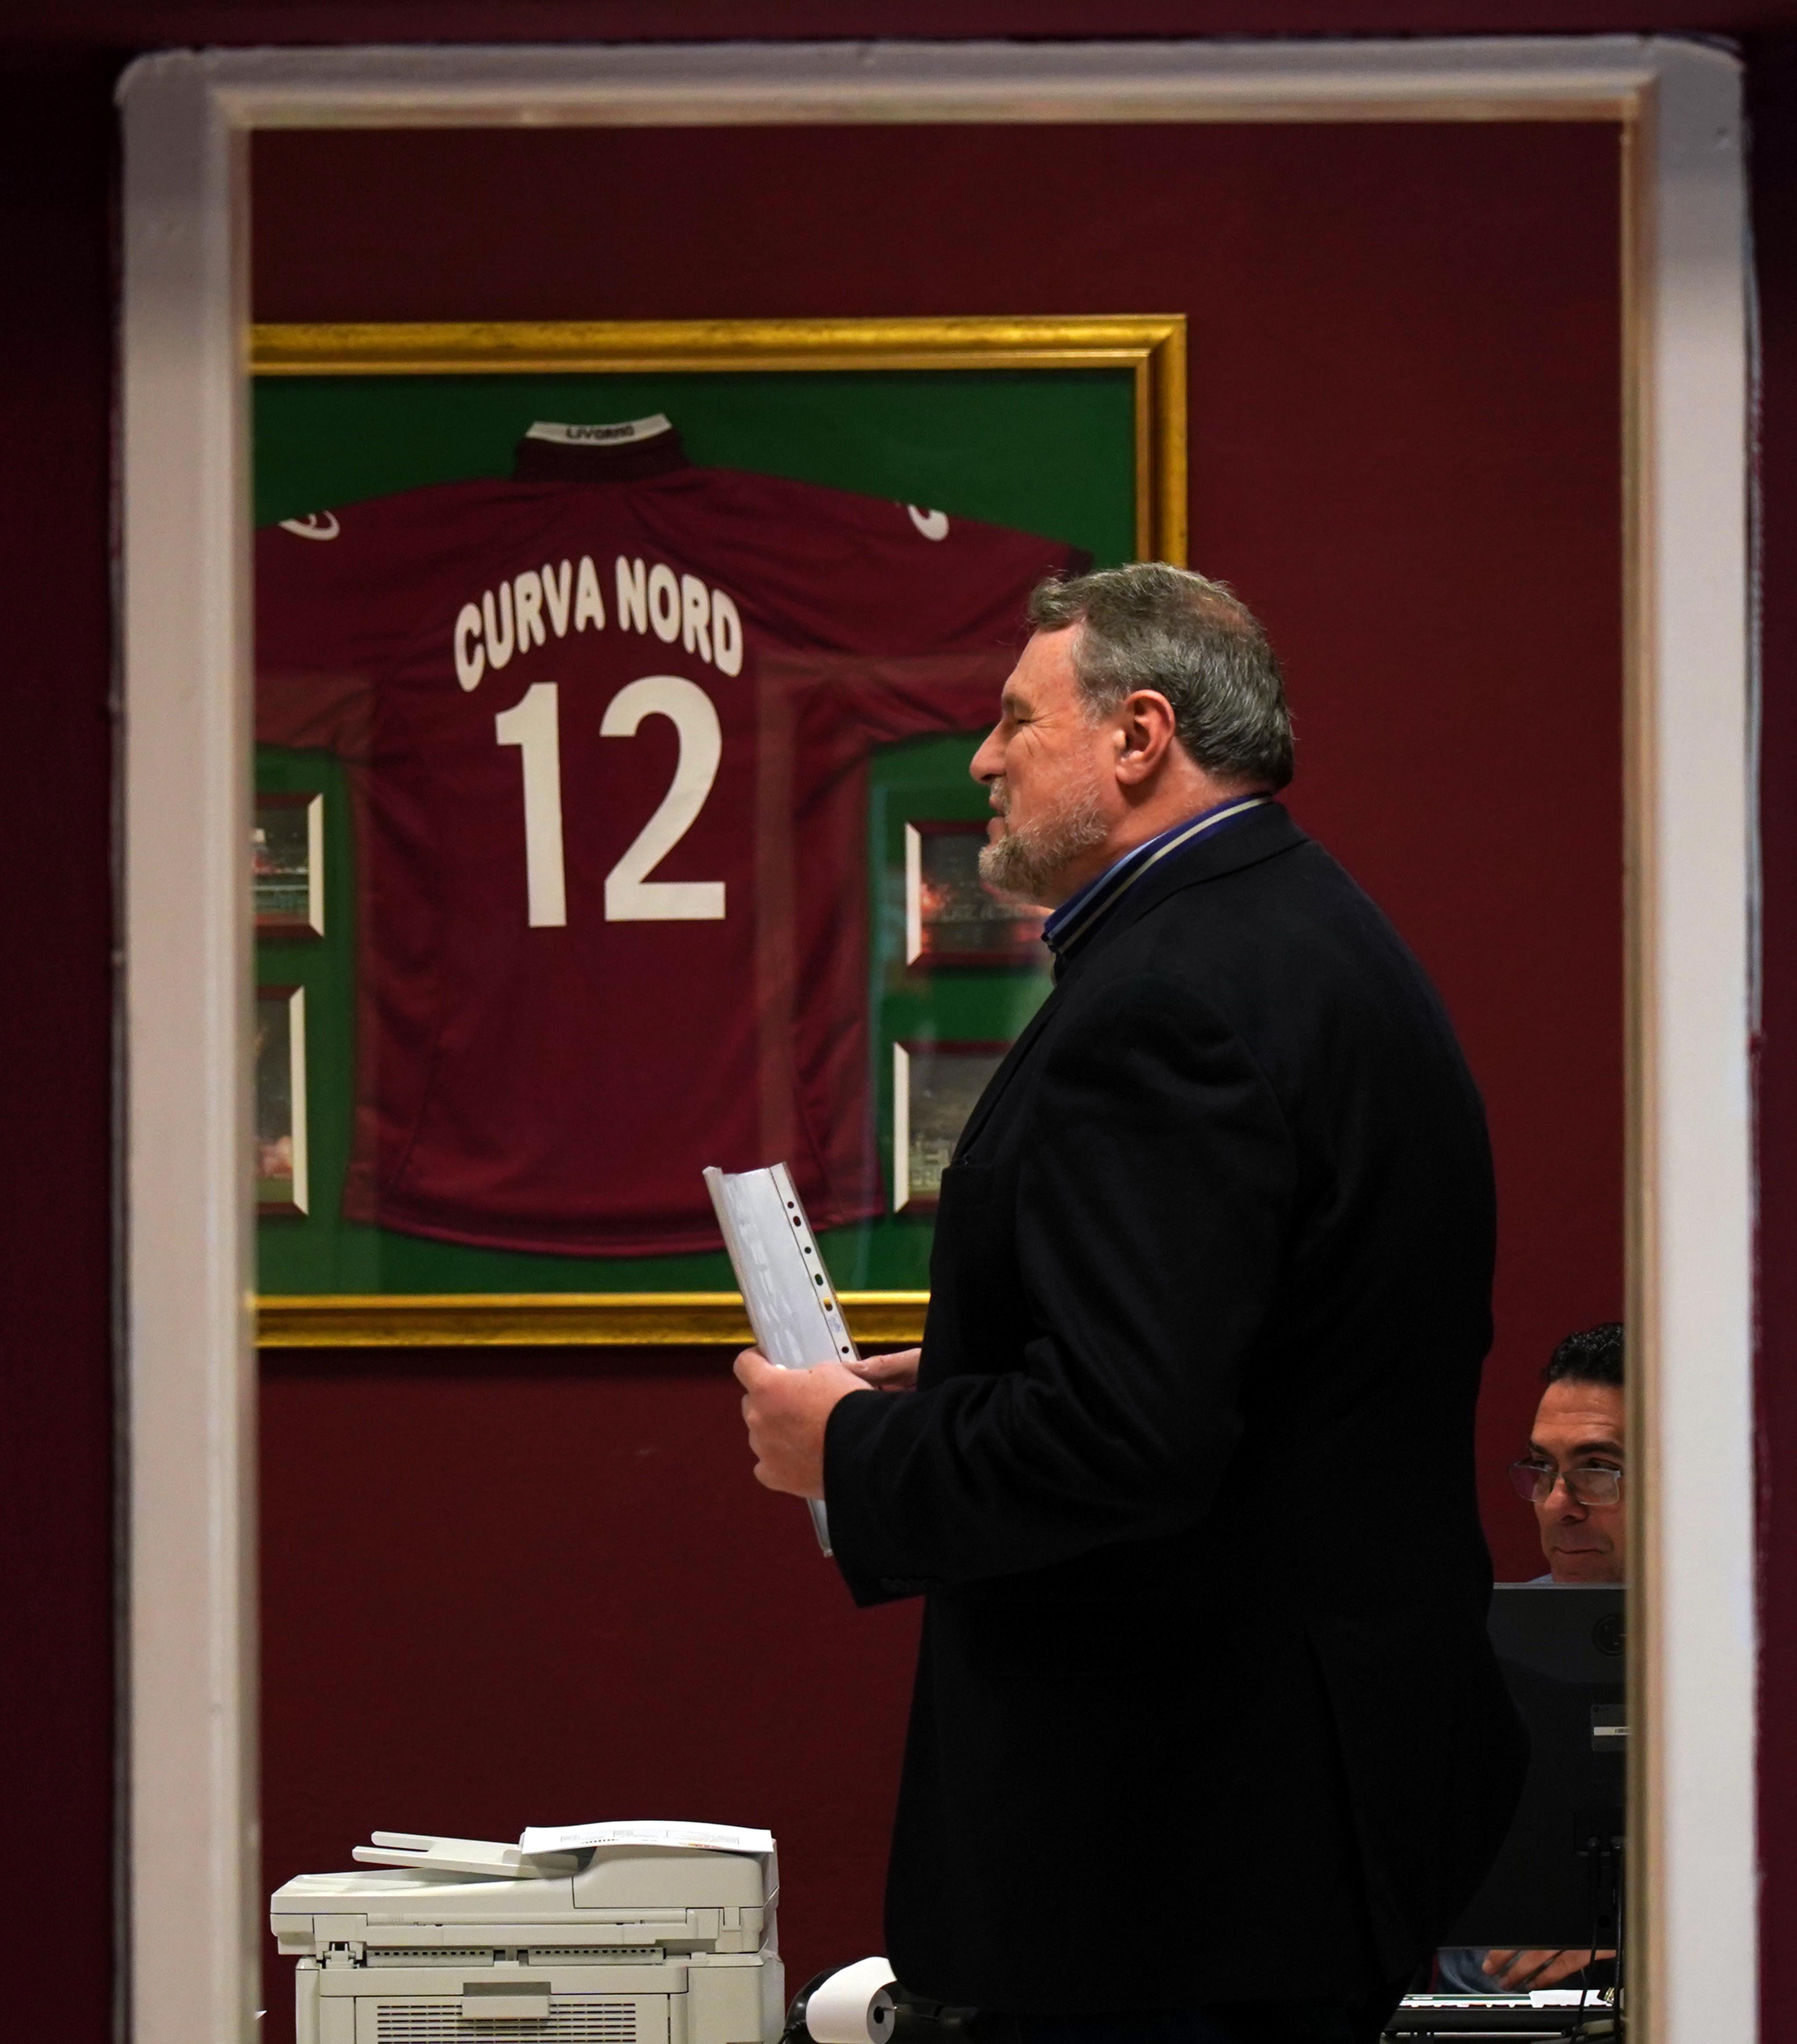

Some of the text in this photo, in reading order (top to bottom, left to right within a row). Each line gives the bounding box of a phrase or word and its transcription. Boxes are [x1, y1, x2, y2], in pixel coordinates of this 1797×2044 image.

[454, 555, 743, 692] CURVA NORD
[494, 674, 726, 928] 12
